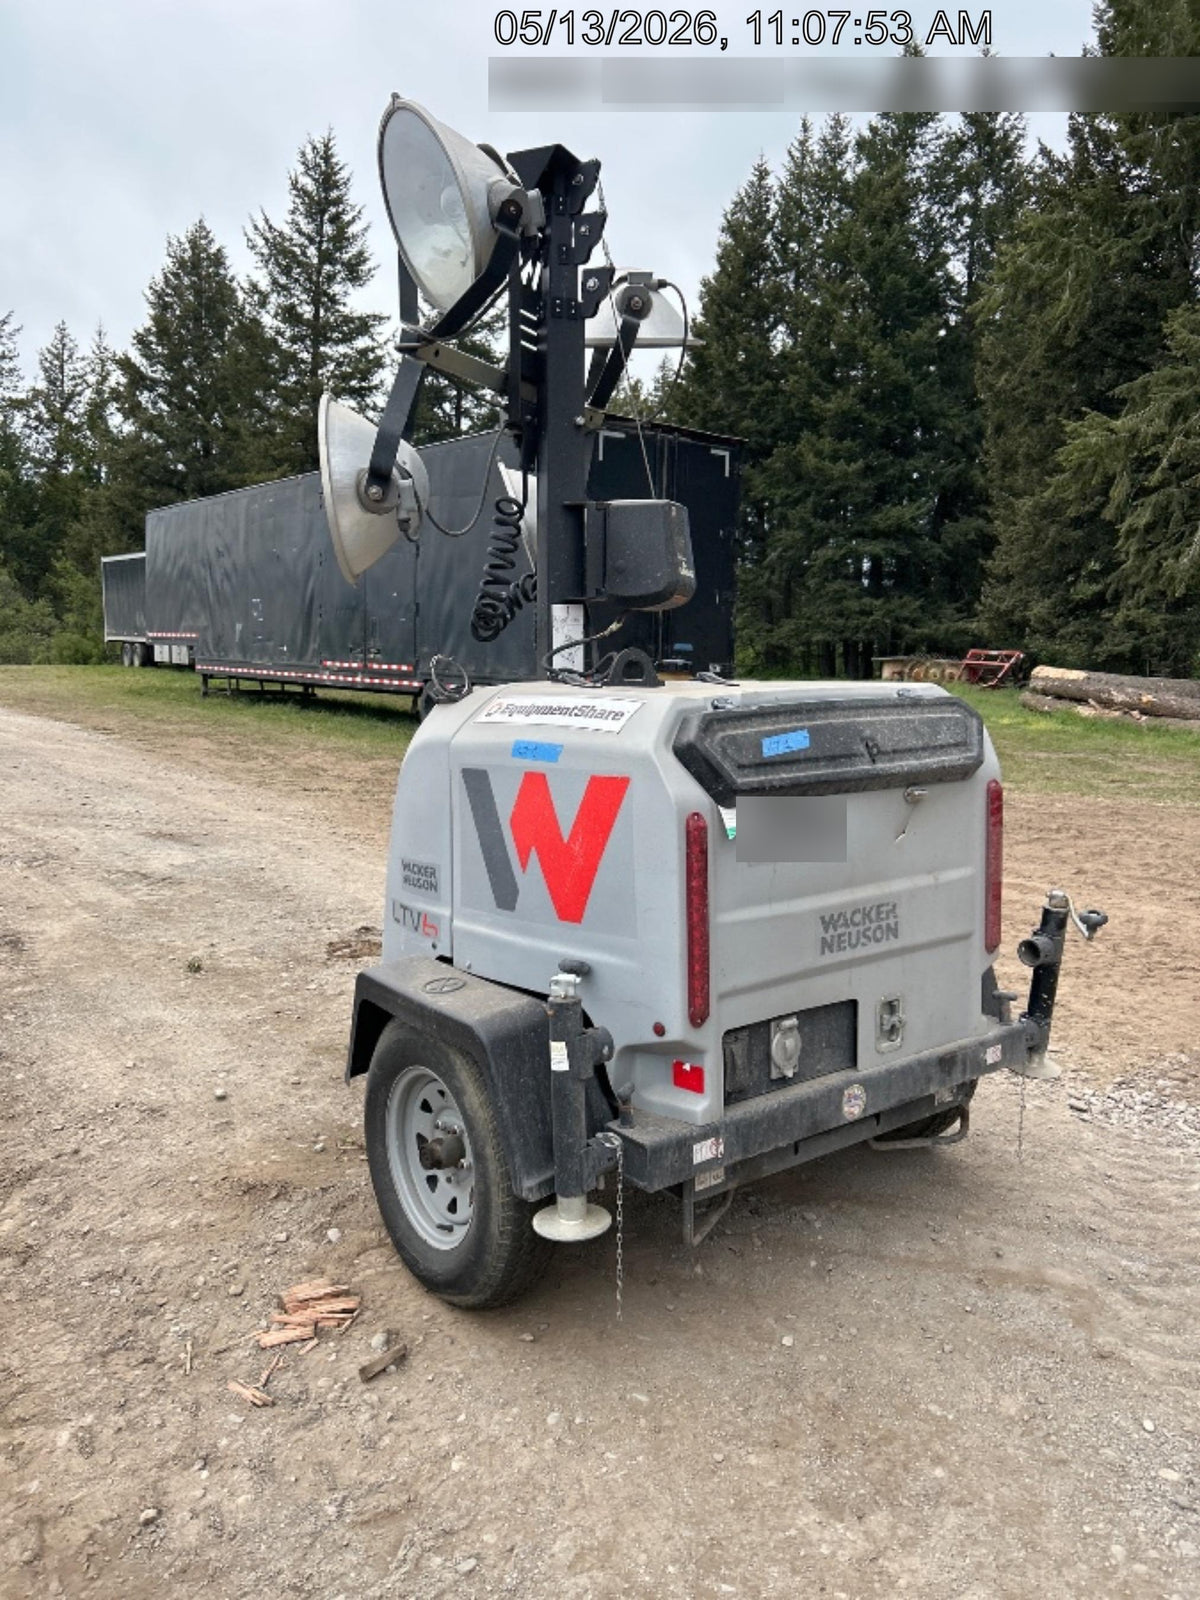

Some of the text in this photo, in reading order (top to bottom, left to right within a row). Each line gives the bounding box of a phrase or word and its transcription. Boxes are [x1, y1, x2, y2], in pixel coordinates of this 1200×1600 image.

[503, 703, 625, 722] EquipmentShare
[819, 902, 898, 934] WACKER
[820, 920, 899, 955] NEUSON
